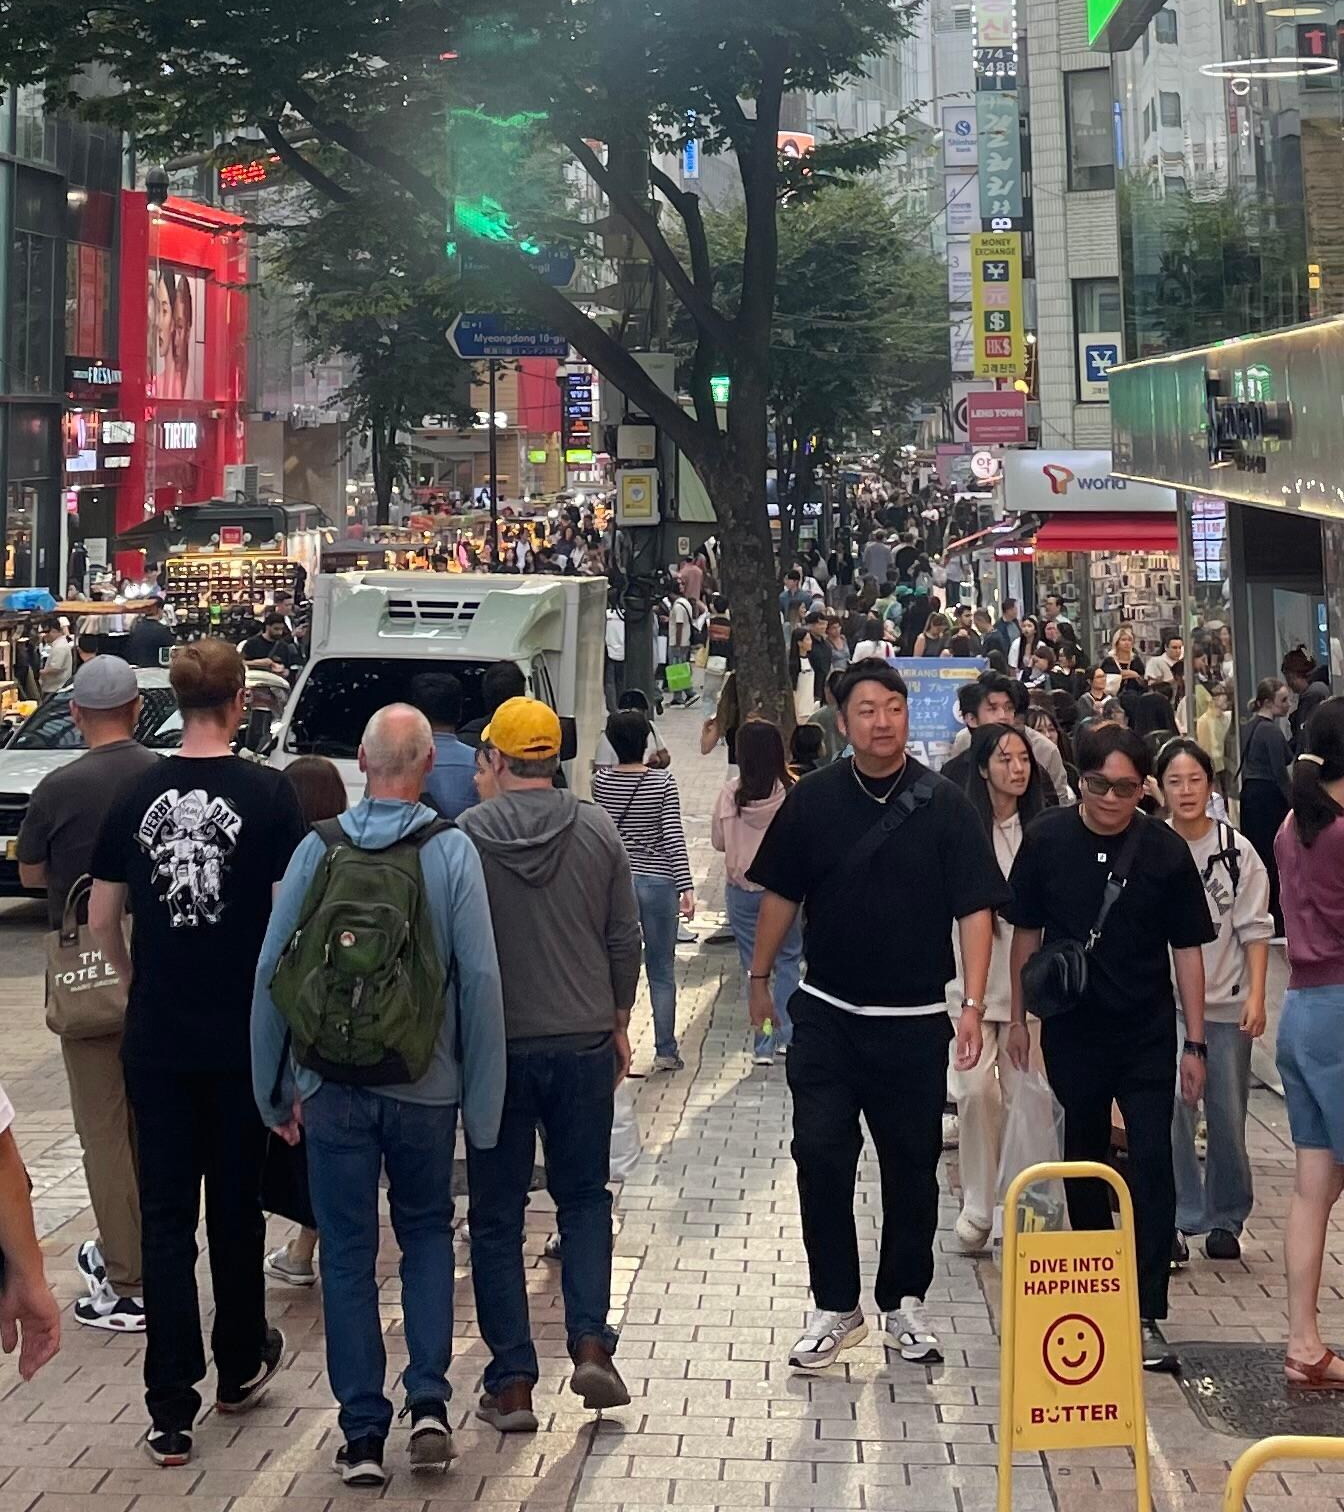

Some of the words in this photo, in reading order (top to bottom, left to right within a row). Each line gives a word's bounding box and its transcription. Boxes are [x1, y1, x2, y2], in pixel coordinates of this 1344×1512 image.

[981, 238, 1010, 246] MONEY
[975, 247, 1016, 256] EXCHANGE
[474, 333, 536, 345] Myeongdong
[538, 333, 565, 345] 10-gil
[986, 338, 1011, 355] HK$
[971, 409, 994, 418] LENS
[995, 408, 1023, 418] TOWN
[163, 422, 197, 449] TIRTIR
[141, 792, 174, 839] DERBY
[211, 803, 239, 831] DAY
[79, 950, 103, 965] TH
[55, 964, 98, 986] TOTE
[1030, 1258, 1068, 1274] DIVE
[1073, 1257, 1114, 1273] INTO
[1024, 1277, 1121, 1296] HAPPINESS
